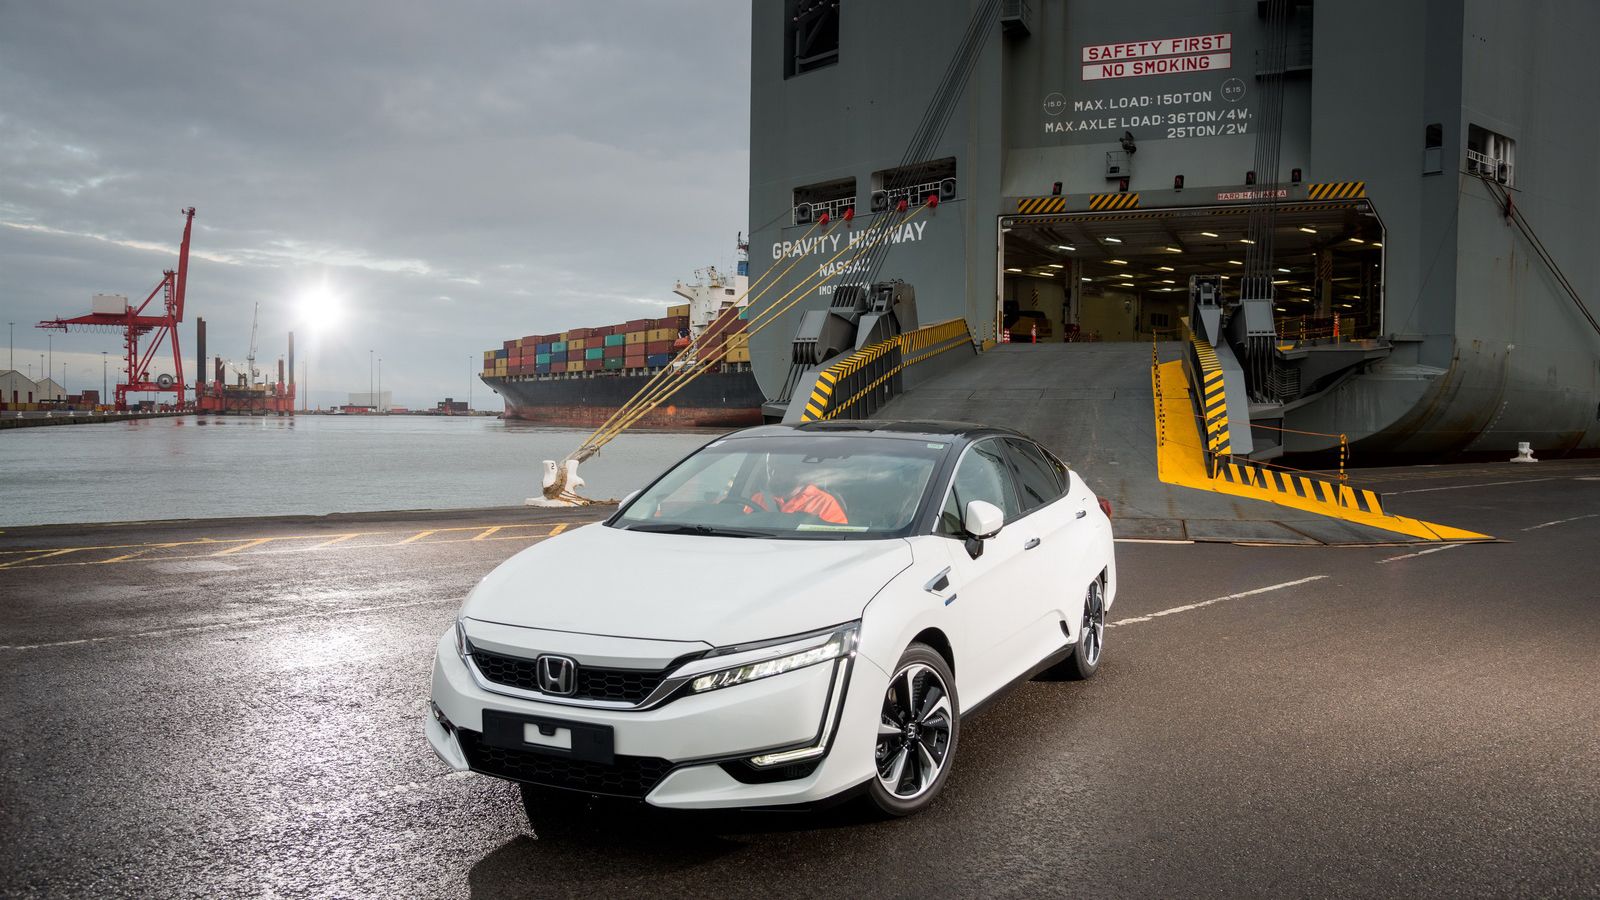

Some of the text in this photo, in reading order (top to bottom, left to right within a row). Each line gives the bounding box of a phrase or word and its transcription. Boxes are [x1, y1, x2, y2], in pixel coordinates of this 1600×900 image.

[1088, 35, 1225, 60] SAFETY FIRST
[1102, 56, 1210, 77] NO SMOKING
[1167, 122, 1248, 139] 25TON/2W
[772, 233, 841, 260] GRAVITY
[819, 285, 832, 296] IMO
